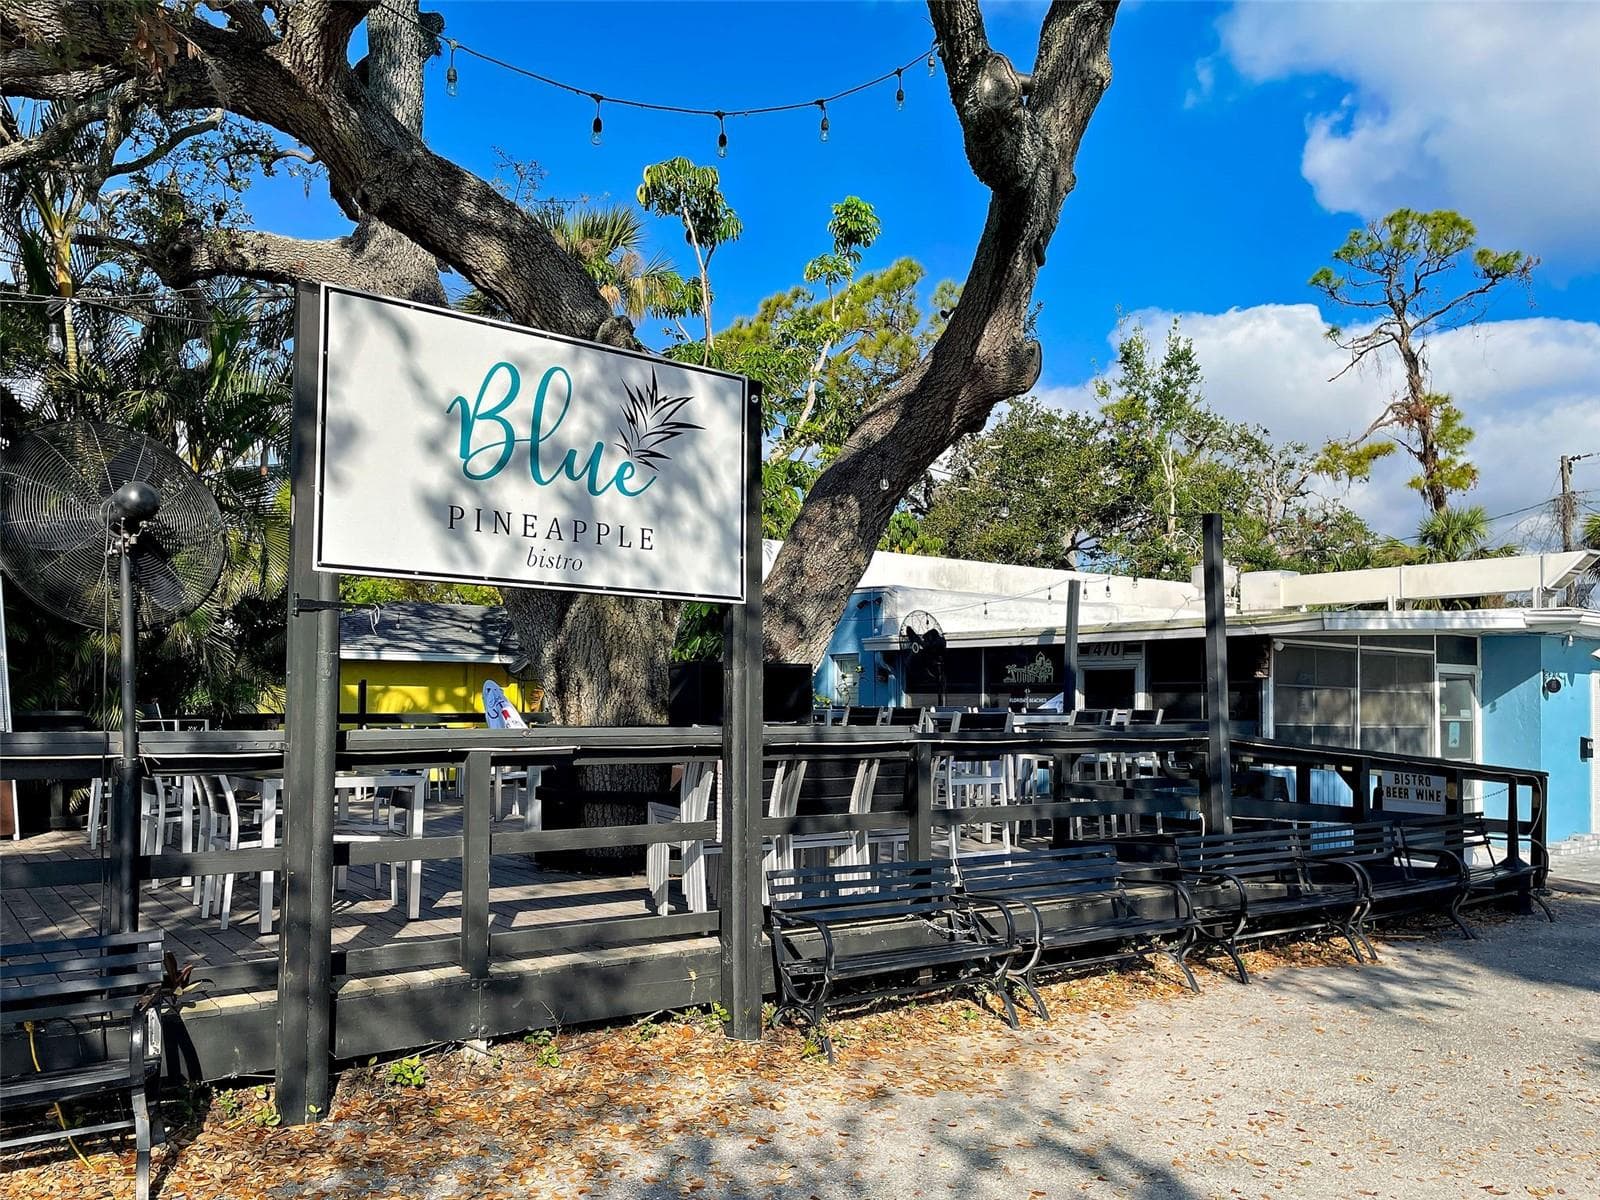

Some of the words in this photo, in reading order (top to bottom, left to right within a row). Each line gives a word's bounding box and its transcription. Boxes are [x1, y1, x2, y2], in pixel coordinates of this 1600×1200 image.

[446, 361, 656, 497] Blue
[448, 505, 654, 550] PINEAPPLE
[526, 546, 583, 571] bistro
[1093, 642, 1120, 657] 470
[1394, 773, 1431, 787] BISTRO
[1386, 786, 1409, 800] BEER
[1416, 789, 1441, 802] WINE
